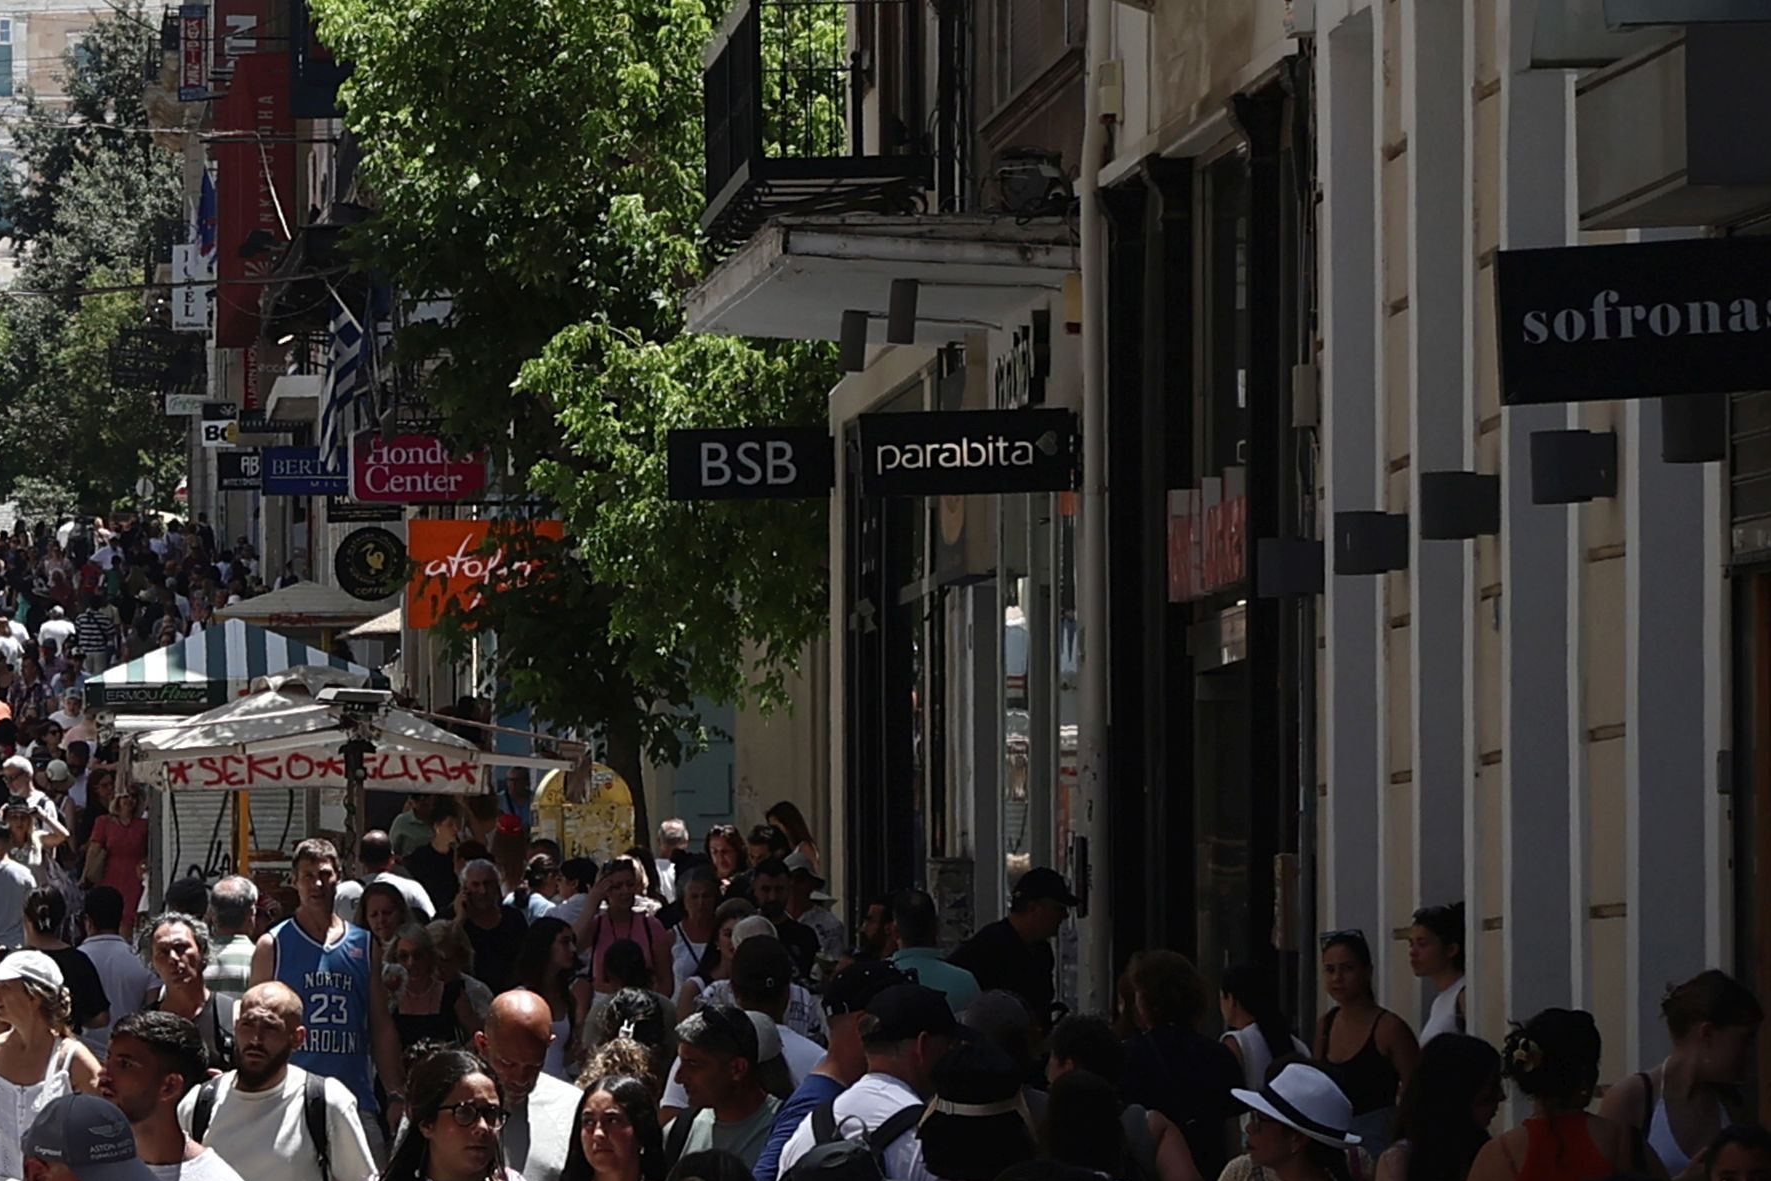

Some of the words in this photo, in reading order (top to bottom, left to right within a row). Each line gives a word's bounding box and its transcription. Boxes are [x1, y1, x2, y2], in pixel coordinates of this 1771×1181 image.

[364, 437, 474, 465] Honds
[699, 440, 799, 488] BSB
[876, 435, 1034, 476] parabita
[364, 464, 464, 493] Center
[354, 586, 392, 597] COFFE
[105, 687, 160, 702] ERMOU
[304, 971, 354, 991] NORTH
[309, 993, 349, 1025] 23
